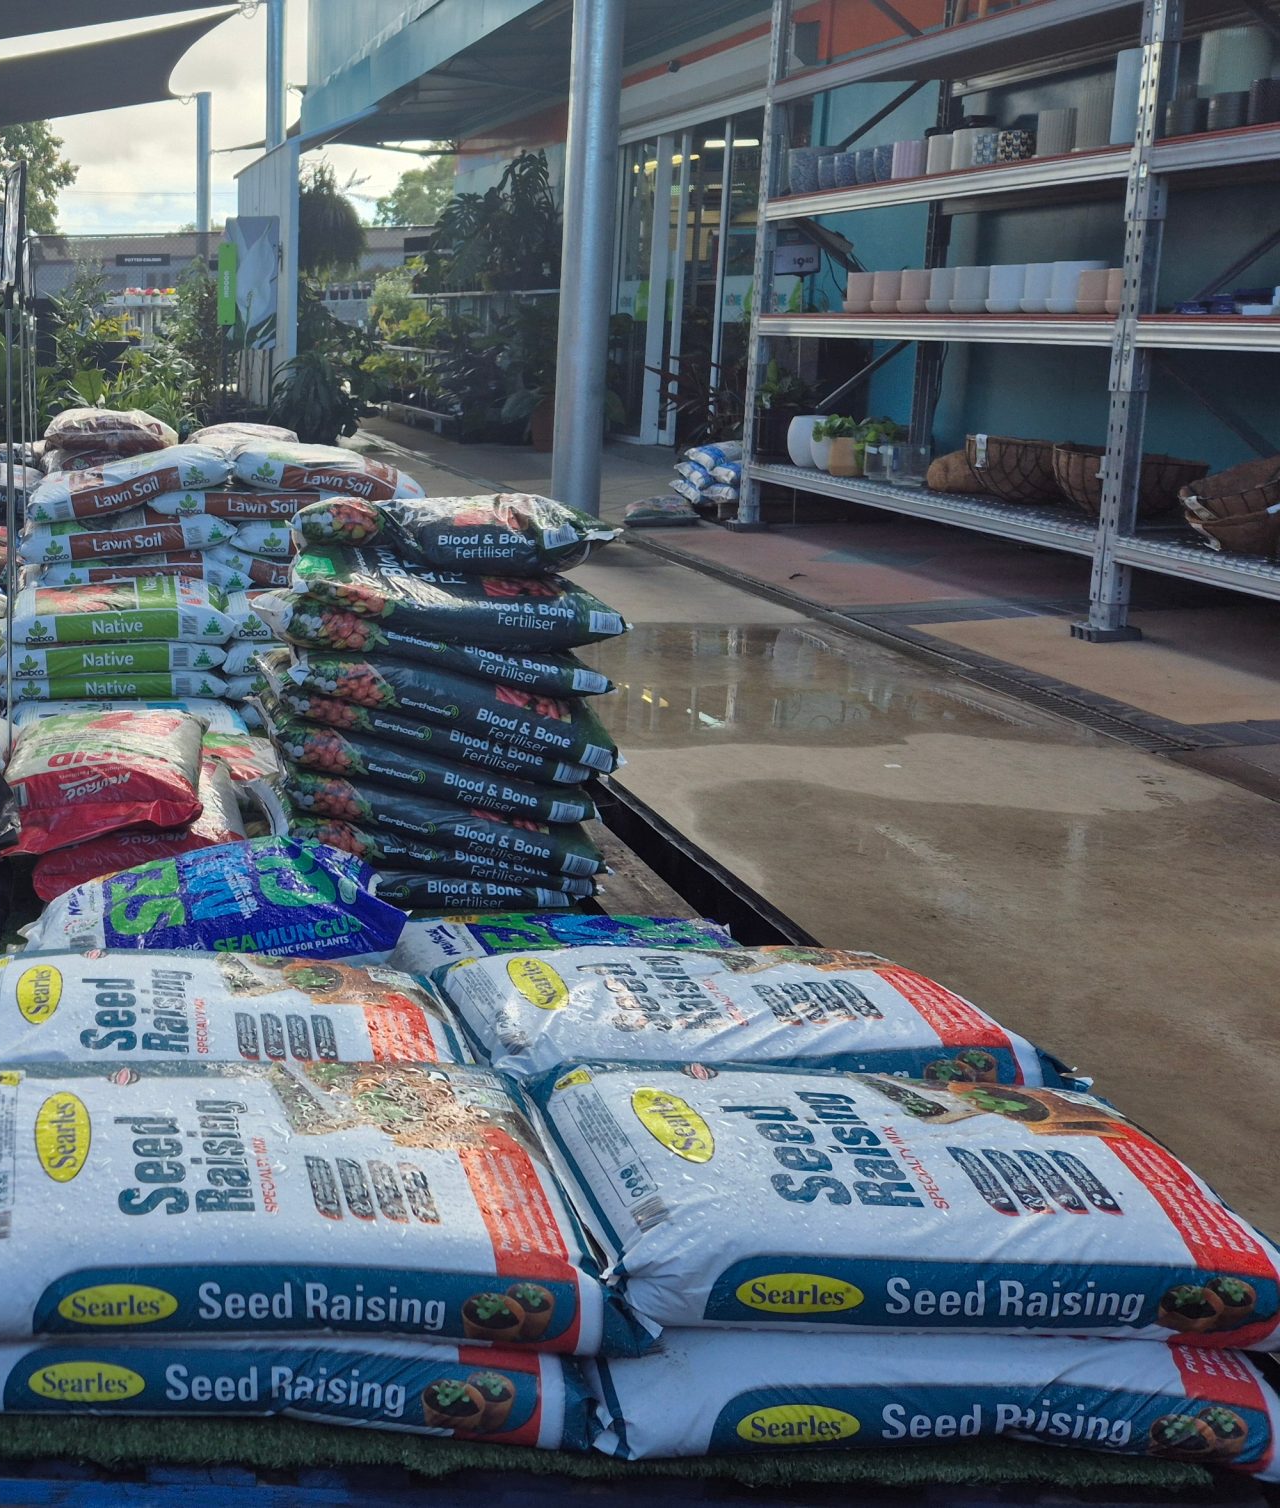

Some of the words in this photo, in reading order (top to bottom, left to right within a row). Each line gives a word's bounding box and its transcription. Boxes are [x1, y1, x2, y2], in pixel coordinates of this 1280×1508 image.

[183, 477, 210, 487] Debco
[251, 474, 277, 485] Debco
[303, 471, 343, 489] Lawn
[345, 476, 374, 496] Soil
[93, 490, 132, 508] Lawn
[133, 476, 160, 497] Soil
[228, 498, 265, 514] Lawn
[270, 498, 298, 514] Soil
[93, 538, 131, 552] Lawn
[135, 531, 163, 548] Soil
[438, 534, 480, 547] Blood
[482, 534, 494, 545] &
[499, 535, 536, 548] Bone
[43, 554, 69, 562] Debco
[455, 547, 517, 559] Fertiliser
[479, 600, 520, 614] Blood
[523, 602, 534, 614] &
[539, 603, 575, 619] Bone
[91, 618, 143, 635] Native
[497, 612, 558, 631] Fertiliser
[26, 635, 54, 643] Debco
[238, 629, 268, 638] Debco
[82, 653, 134, 668] Native
[242, 665, 261, 673] Deb
[465, 646, 504, 665] Blood
[506, 655, 519, 667] &
[522, 659, 560, 675] Bone
[16, 669, 44, 677] Debco
[478, 660, 541, 685] Fertiliser
[85, 681, 136, 695] Native
[400, 698, 453, 718] Earthcore
[374, 719, 426, 740] Earthcore
[476, 708, 518, 732] Blood
[520, 721, 531, 734] &
[534, 727, 571, 748] Bone
[449, 729, 490, 751] Blood
[493, 742, 504, 755] &
[507, 745, 544, 767] Bone
[487, 727, 548, 754] Fertiliser
[462, 747, 523, 774] Fertiliser
[367, 763, 421, 783] Earthcore
[443, 771, 485, 793] Blood
[487, 783, 498, 797] &
[501, 787, 538, 808] Bone
[456, 790, 517, 814] Fertiliser
[378, 814, 431, 835] Earthcore
[454, 823, 496, 846] Blood
[498, 835, 510, 849] &
[513, 839, 551, 860] Bone
[383, 845, 433, 862] Eartcore
[467, 842, 530, 864] Fertiliser
[499, 857, 510, 869] &
[469, 864, 530, 885] Fertiliser
[427, 881, 467, 894] Blood
[471, 881, 482, 894] &
[487, 883, 523, 897] Bone
[444, 896, 504, 910] Fertiliser
[213, 914, 362, 953] SEAMUNGUS
[266, 944, 294, 957] TONIC
[296, 941, 313, 952] FOR
[314, 935, 350, 948] PLANTS
[25, 966, 53, 1018] Searles
[79, 978, 138, 1053] Seed
[140, 968, 195, 1054] Raising
[48, 1098, 78, 1171] Searles
[880, 1125, 906, 1149] MIX
[186, 1098, 258, 1214] Raising
[718, 1103, 854, 1207] Seed
[793, 1090, 925, 1208] Raising
[117, 1116, 190, 1217] Seed
[893, 1147, 950, 1210] SPECIALTY
[71, 1294, 161, 1318] Searles
[198, 1282, 294, 1320] Seed
[305, 1284, 447, 1331] Raising
[750, 1283, 845, 1306] Searles
[884, 1276, 989, 1317] Seed
[999, 1280, 1145, 1322] Raising
[41, 1370, 128, 1394] Searles
[165, 1364, 260, 1402] Seed
[270, 1366, 408, 1419] Raising
[750, 1416, 843, 1440] Searles
[881, 1403, 983, 1441] Seed
